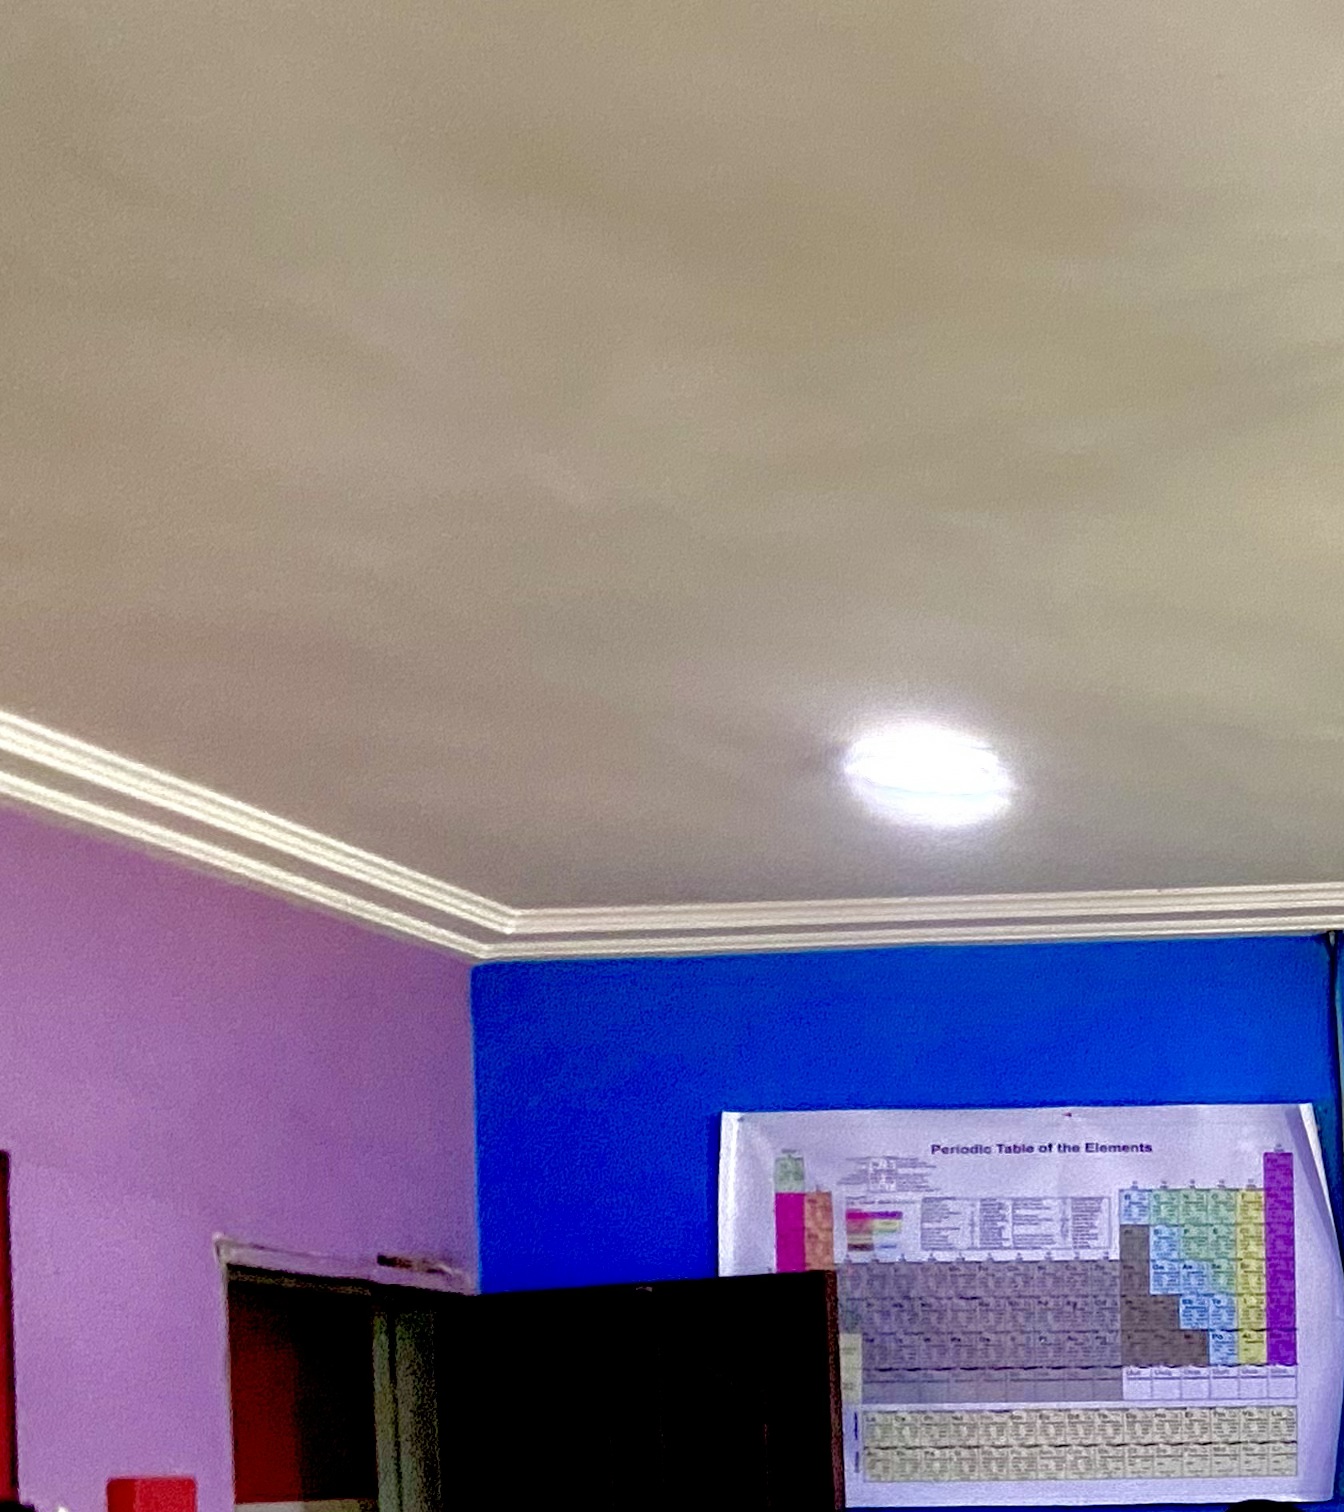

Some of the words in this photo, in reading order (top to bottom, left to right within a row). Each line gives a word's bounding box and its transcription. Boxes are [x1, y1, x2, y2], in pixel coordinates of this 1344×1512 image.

[931, 1144, 991, 1155] Periodic
[998, 1144, 1034, 1154] Table
[1038, 1143, 1053, 1154] of
[1057, 1143, 1081, 1154] the
[1085, 1142, 1153, 1154] Elements
